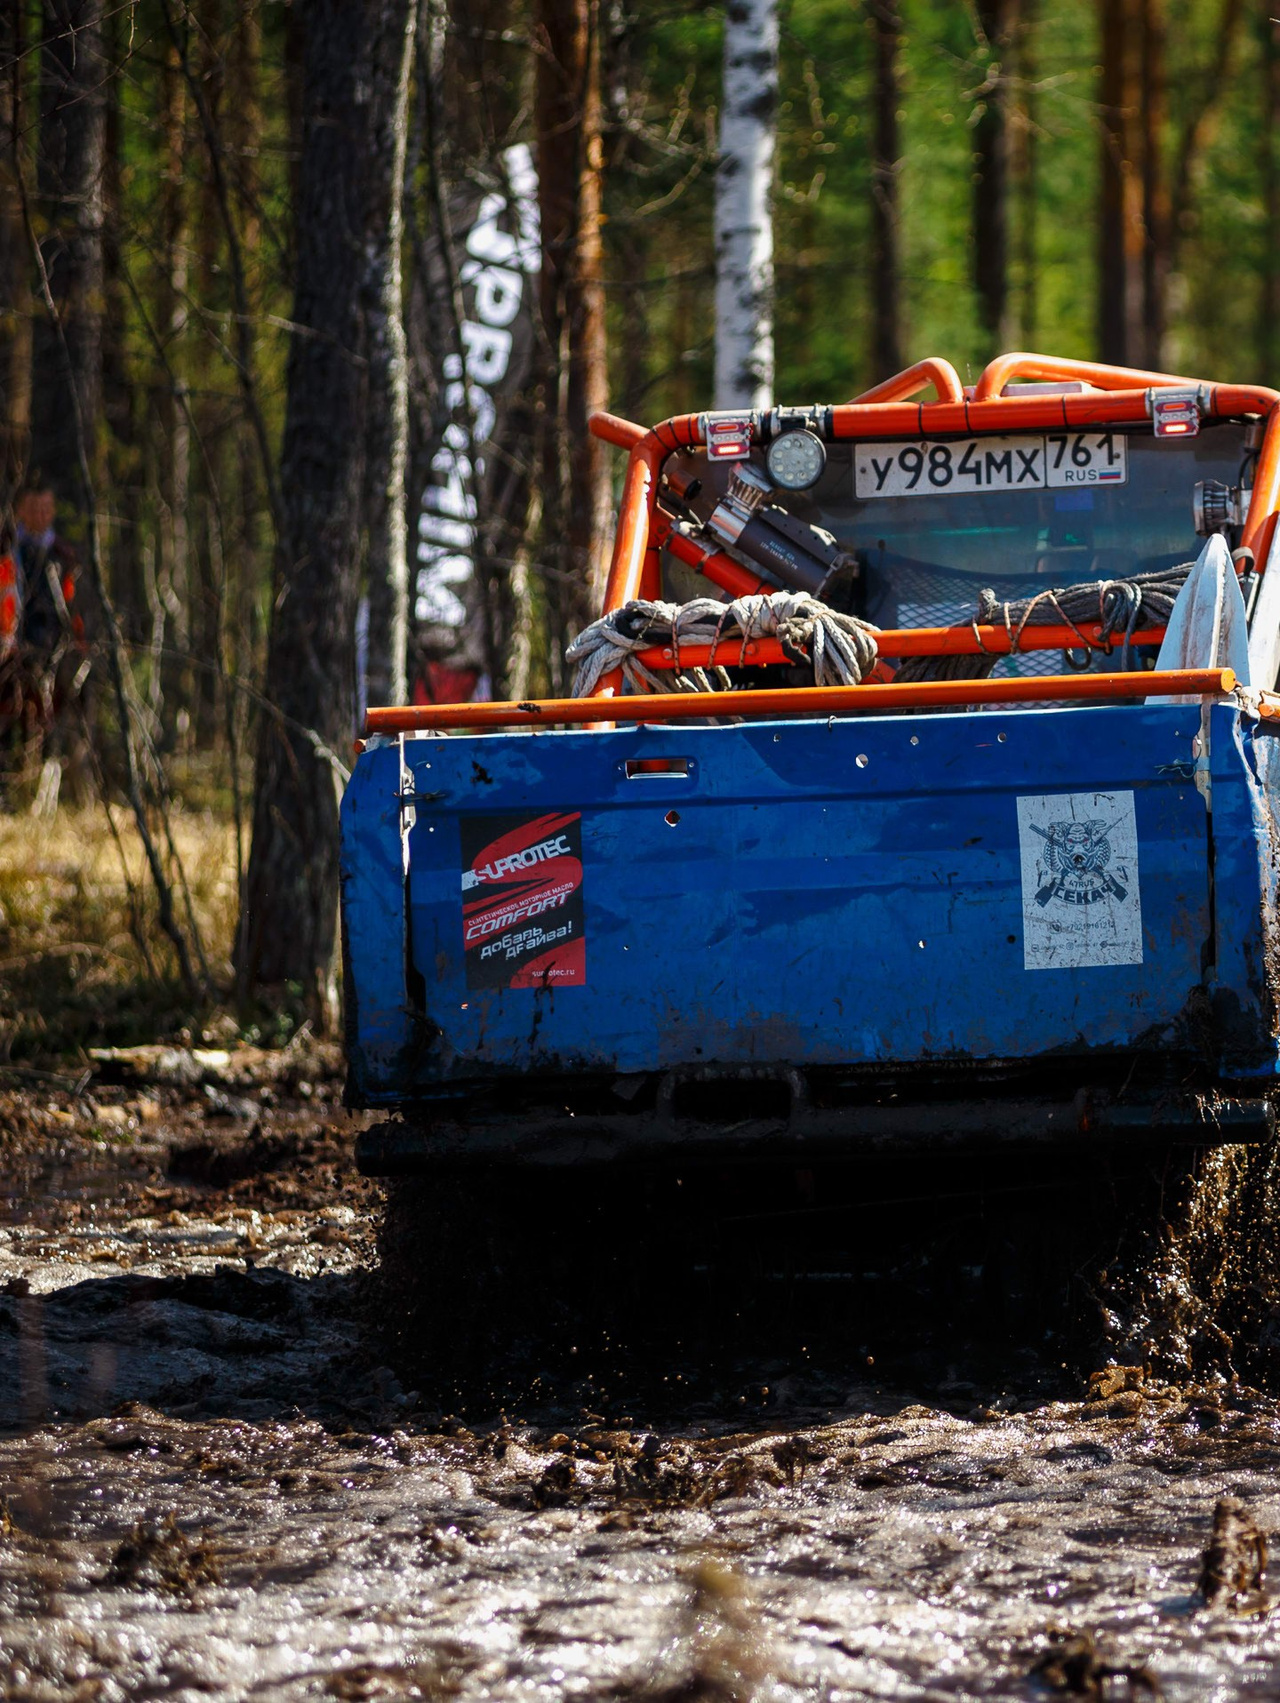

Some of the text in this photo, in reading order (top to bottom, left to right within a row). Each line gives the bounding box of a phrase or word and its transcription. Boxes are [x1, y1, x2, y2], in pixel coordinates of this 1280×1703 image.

[1048, 434, 1115, 469] 761
[1064, 468, 1098, 482] RUS
[473, 835, 571, 882] SUPROTEC
[519, 889, 551, 907] МОТОРНОЕ
[552, 881, 574, 895] МАСЛО
[1053, 881, 1115, 904] СЕКАЧ
[466, 890, 572, 941] COMFORT
